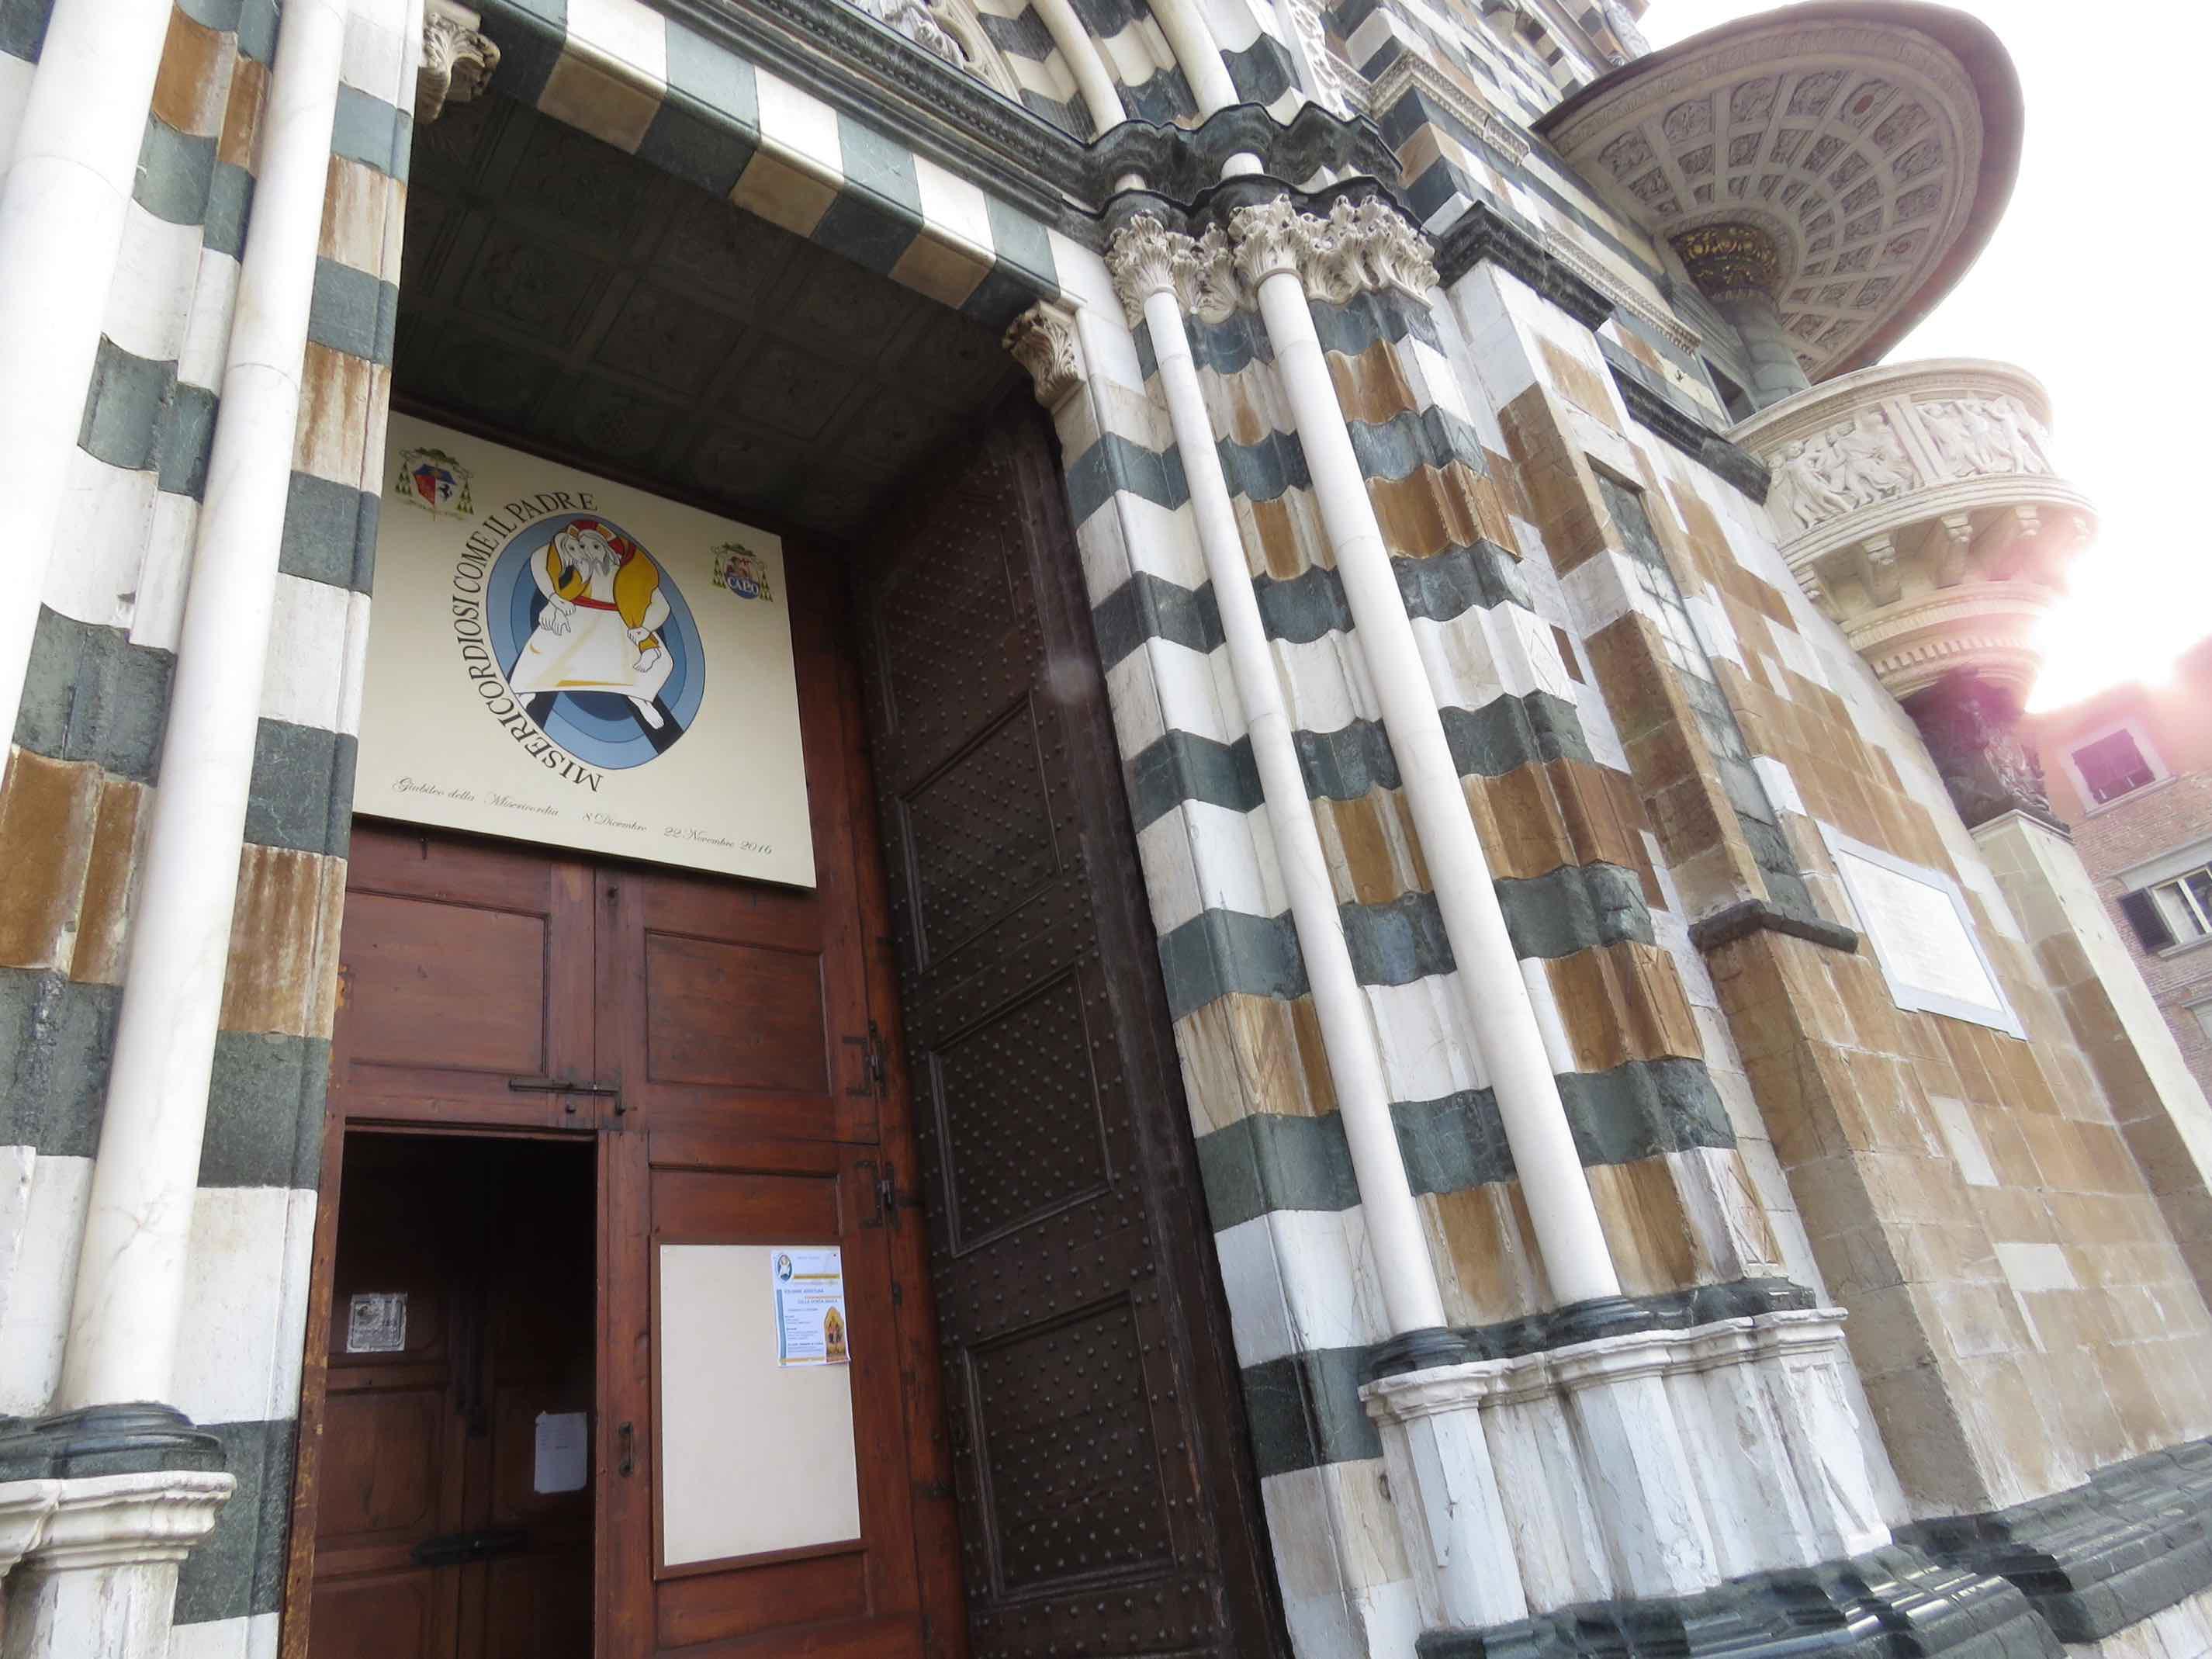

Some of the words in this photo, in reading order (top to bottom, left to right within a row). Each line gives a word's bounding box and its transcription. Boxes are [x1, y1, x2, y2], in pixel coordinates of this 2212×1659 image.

[483, 513, 518, 540] IL
[504, 491, 597, 528] PADRE
[453, 531, 492, 594] COME
[452, 595, 604, 792] MISERICORDIOSI
[392, 777, 444, 795] Giubileo
[448, 788, 475, 802] della
[483, 790, 559, 817] Misericordia
[594, 812, 648, 833] Dicembre
[663, 827, 682, 839] 22
[682, 825, 736, 849] Novembre
[739, 840, 773, 856] 2016
